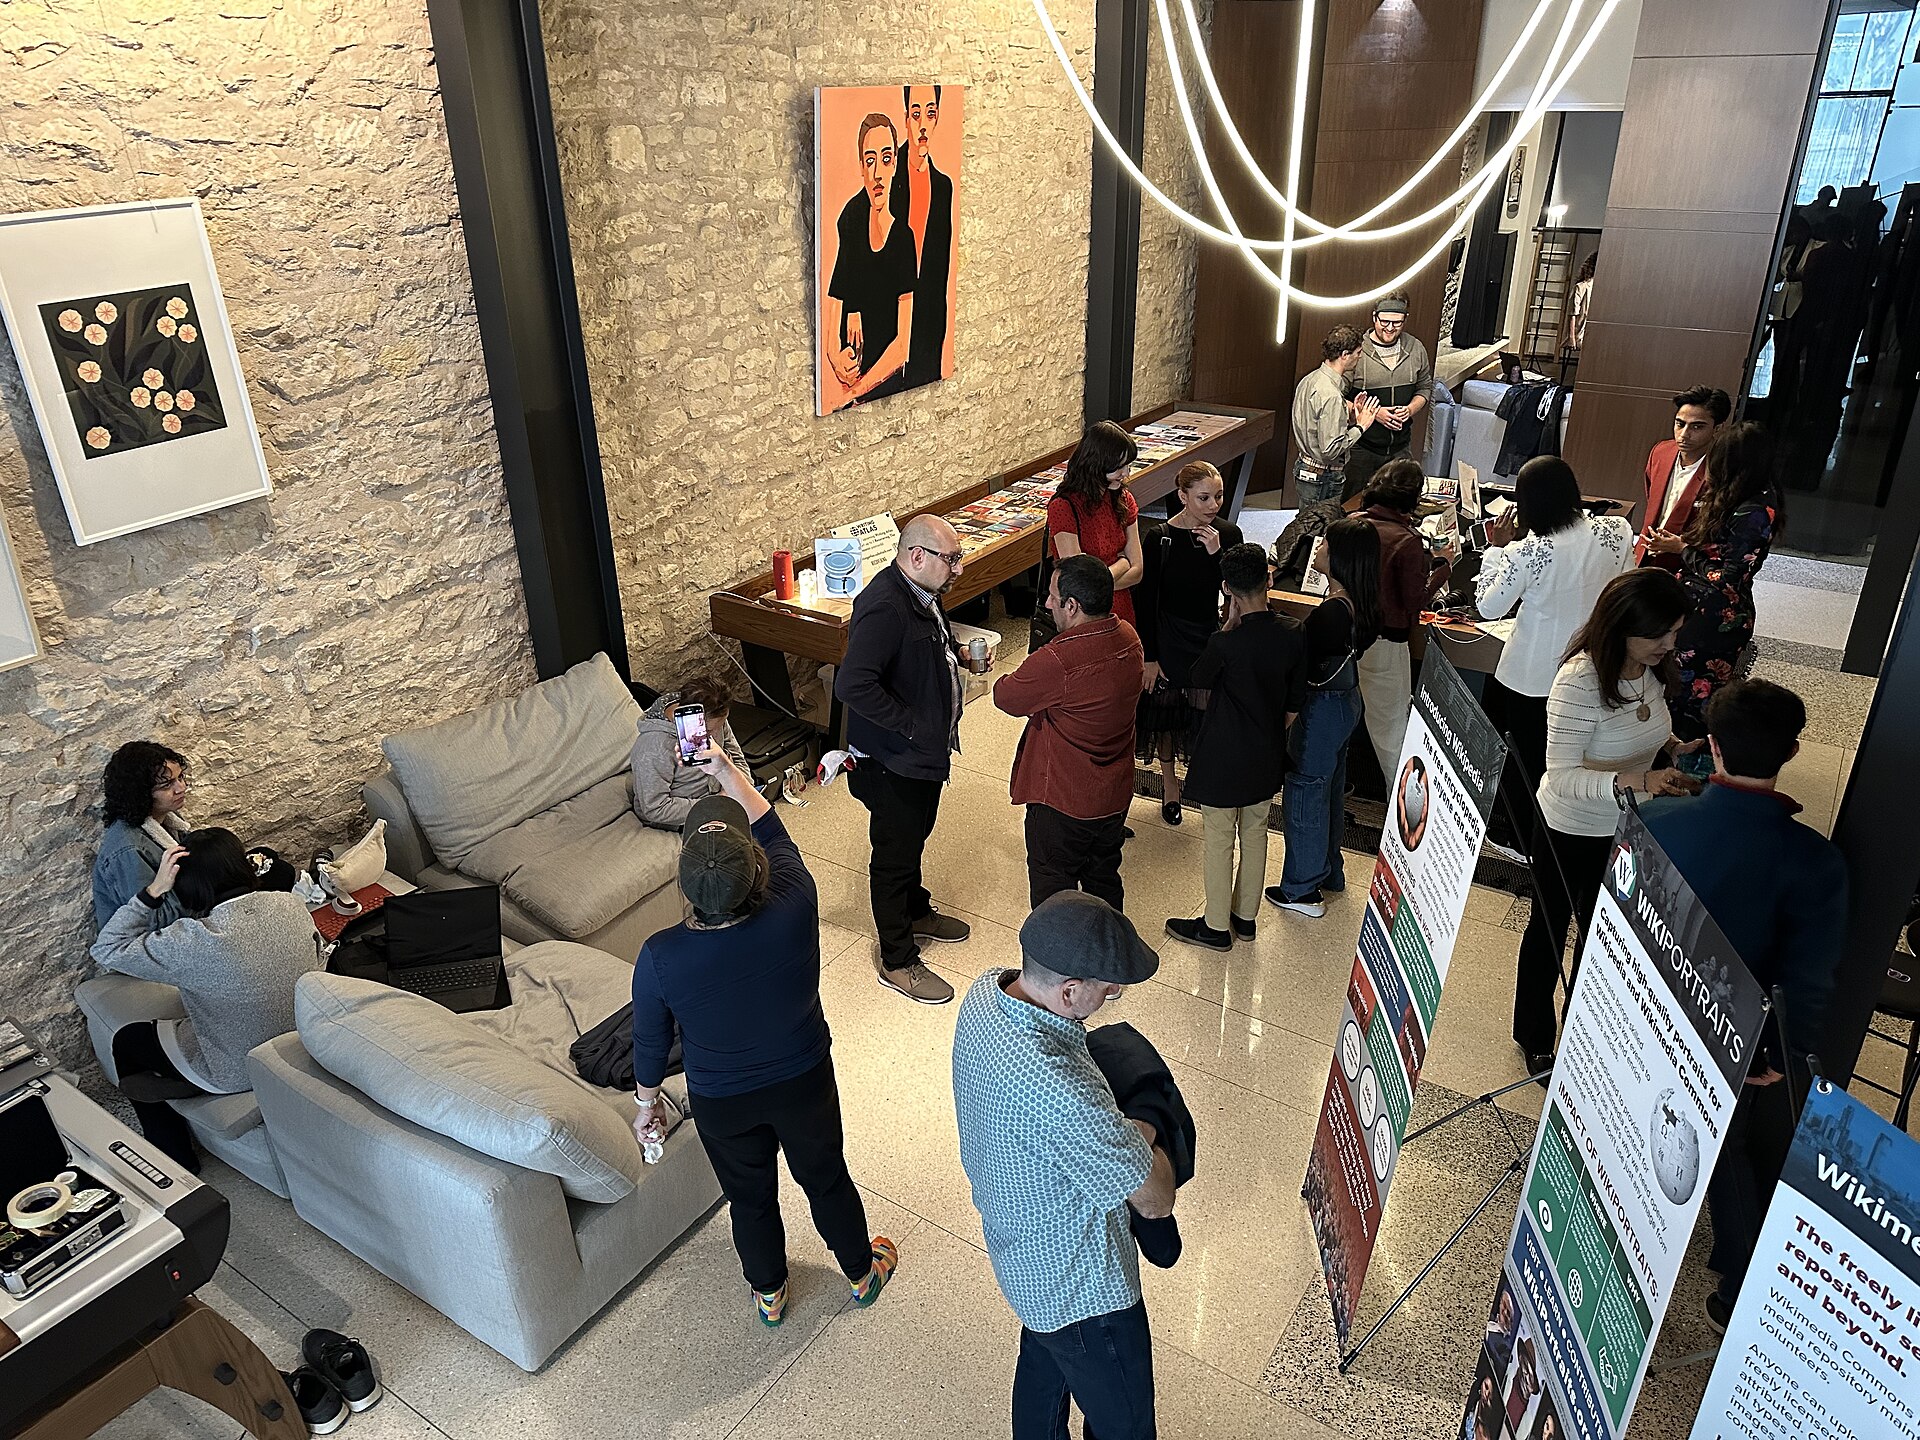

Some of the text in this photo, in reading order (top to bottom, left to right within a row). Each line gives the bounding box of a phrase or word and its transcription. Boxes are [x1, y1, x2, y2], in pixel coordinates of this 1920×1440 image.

[860, 525, 878, 535] ATLAS
[1420, 684, 1483, 792] Introducing Wikipedia
[1423, 732, 1479, 840] The free encyclopedia
[1433, 776, 1476, 856] anyone can edit
[1374, 875, 1394, 918] Point of View
[1380, 872, 1392, 899] Neutral
[1384, 841, 1394, 863] THAT
[1394, 860, 1405, 885] MAKE
[1404, 882, 1422, 922] WIKIPEDIA
[1387, 829, 1416, 888] THE GUIDELINES
[1618, 856, 1632, 884] W
[1590, 953, 1644, 1050] WikiPortraits brings skilled
[1600, 907, 1721, 1111] Capturing high-quality portraits for
[1636, 888, 1744, 1064] WIKIPORTRAITS
[1583, 979, 1641, 1084] document history and enrich
[1586, 967, 1650, 1081] photographers to key events to
[1596, 923, 1717, 1138] Wikipedia and Wikimedia Commons
[1572, 1023, 1594, 1065] knowledge
[1593, 1064, 1602, 1081] and
[1602, 1081, 1624, 1126] multimedia
[1624, 1125, 1642, 1160] content
[1575, 1011, 1645, 1148] Wikipedia is dedicated to providing
[1328, 1099, 1337, 1128] share
[1336, 1120, 1340, 1132] in
[1348, 1165, 1353, 1175] of
[1331, 1088, 1340, 1112] single
[1339, 1111, 1349, 1141] human
[1348, 1140, 1356, 1167] being
[1359, 1183, 1368, 1210] freely
[1348, 1120, 1357, 1145] world
[1354, 1142, 1359, 1154] in
[1358, 1154, 1366, 1181] which
[1560, 1126, 1573, 1151] HOW
[1566, 1045, 1667, 1254] licensed photos, and don't use just any image from
[1568, 1036, 1667, 1232] anyone to freely use. That's why we need openly
[1558, 1081, 1586, 1136] IMPACT
[1585, 1137, 1598, 1159] OF
[1597, 1160, 1658, 1301] WIKIPORTRAITS:
[1589, 1189, 1607, 1229] WHERE
[1627, 1273, 1640, 1303] WHY
[1786, 1242, 1894, 1334] repository
[1795, 1215, 1833, 1254] The
[1839, 1253, 1901, 1310] freely
[1526, 1233, 1603, 1439] VISIT LEARN CONTRIBUTE
[1759, 1317, 1830, 1384] volunteers.
[1764, 1304, 1804, 1341] media
[1804, 1341, 1877, 1404] repository
[1770, 1287, 1913, 1418] Wikimedia Commons
[1777, 1263, 1905, 1377] and beyond.
[1734, 1384, 1786, 1434] all types
[1737, 1371, 1807, 1433] attributed.
[1745, 1356, 1781, 1391] freely
[1749, 1344, 1798, 1390] Anyone
[1802, 1391, 1826, 1415] can
